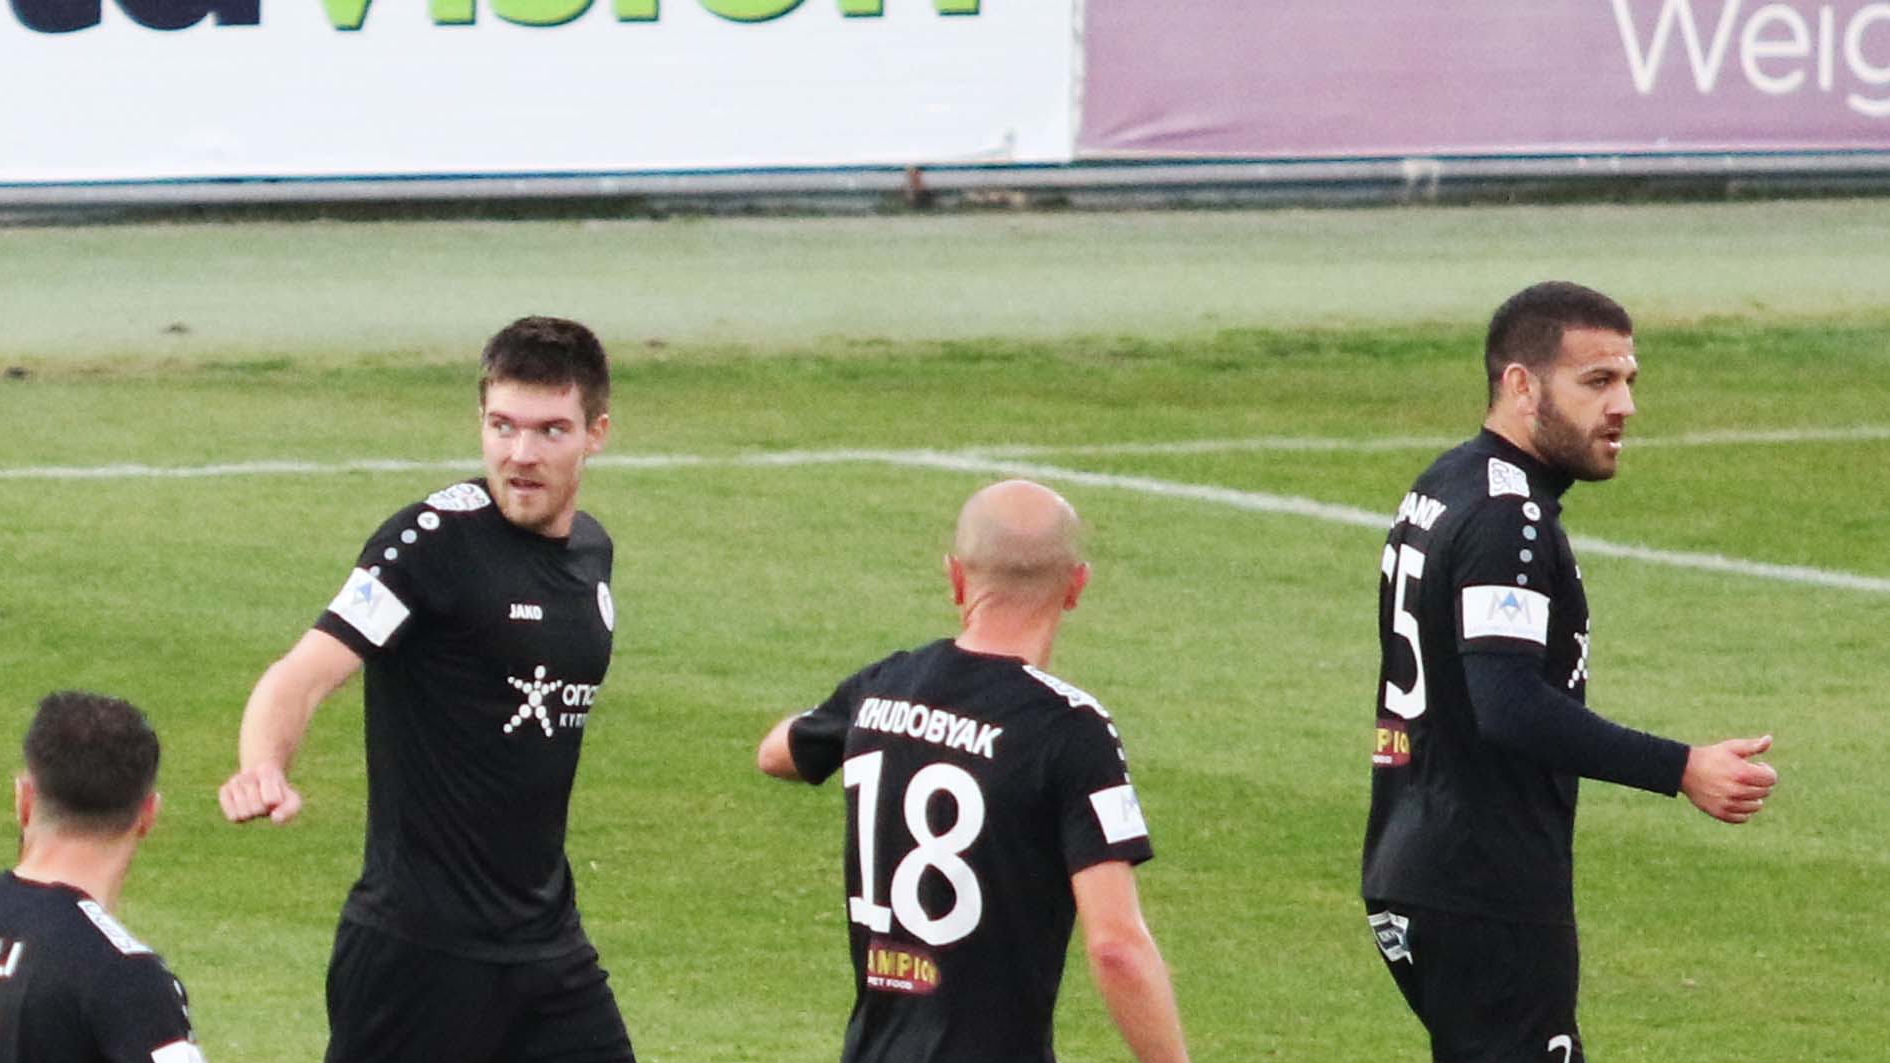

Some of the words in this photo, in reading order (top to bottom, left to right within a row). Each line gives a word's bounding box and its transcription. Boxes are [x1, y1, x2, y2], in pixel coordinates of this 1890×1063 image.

[509, 603, 543, 622] JAKO
[854, 697, 1004, 760] KHUDOBYAK
[843, 750, 986, 947] 18
